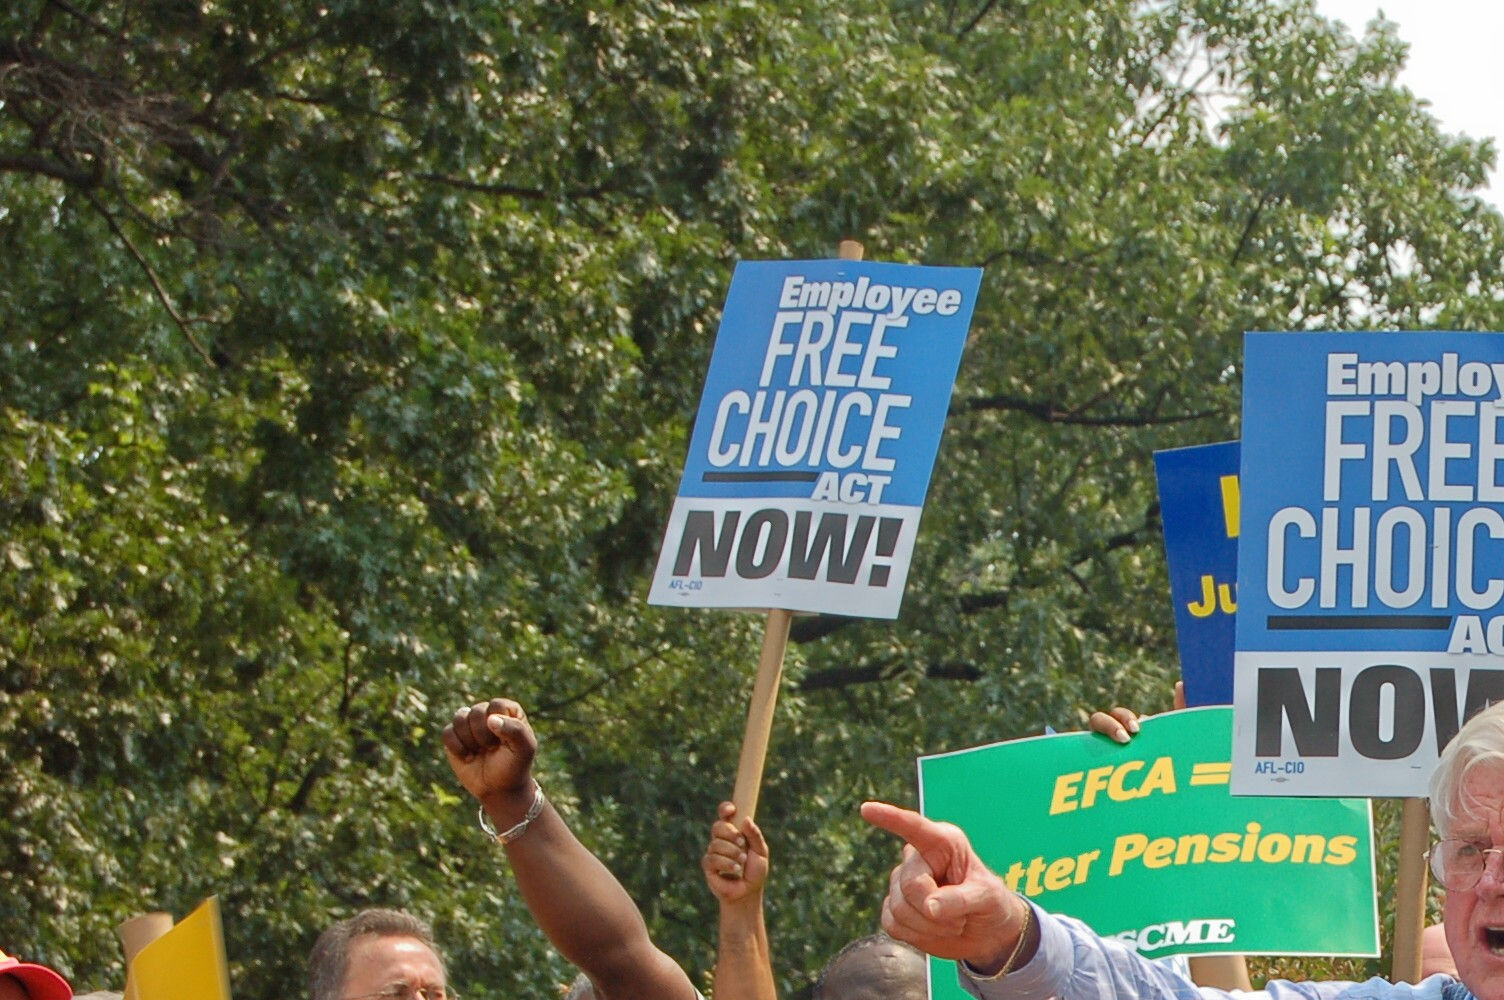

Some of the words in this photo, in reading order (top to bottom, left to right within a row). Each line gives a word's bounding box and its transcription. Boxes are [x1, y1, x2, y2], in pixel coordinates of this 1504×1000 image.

[779, 275, 962, 323] Employee
[760, 312, 908, 389] FREE
[707, 389, 911, 471] CHOICE
[811, 472, 891, 504] ACT
[671, 508, 904, 587] NOW!
[1049, 757, 1176, 815] EFCA
[1255, 762, 1305, 775] AFL-CIO
[1109, 822, 1357, 878] Pensions
[1101, 919, 1236, 951] SCME
